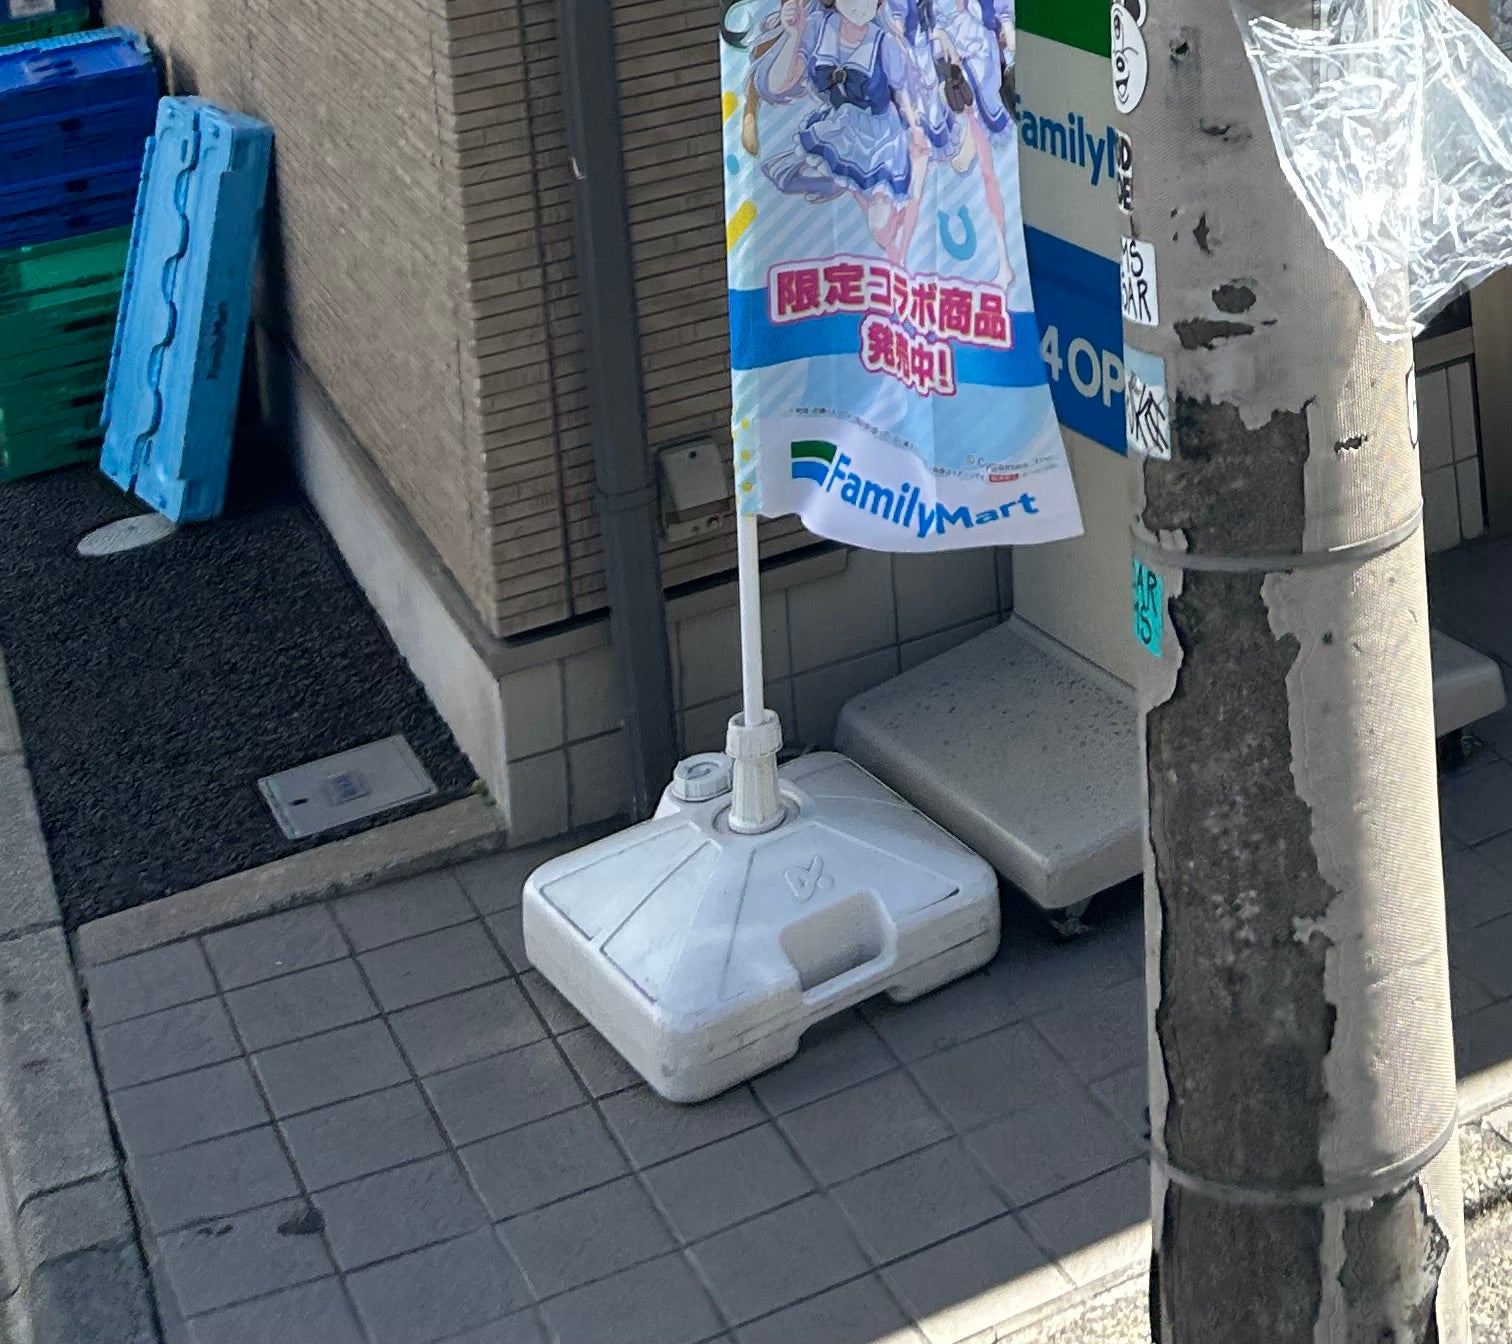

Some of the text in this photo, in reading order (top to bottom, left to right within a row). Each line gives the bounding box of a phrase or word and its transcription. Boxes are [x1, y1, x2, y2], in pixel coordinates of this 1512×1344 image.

[771, 260, 1012, 346] 限定コラボ商品
[865, 320, 954, 394] 発売中!
[825, 451, 1040, 540] FamilyMart
